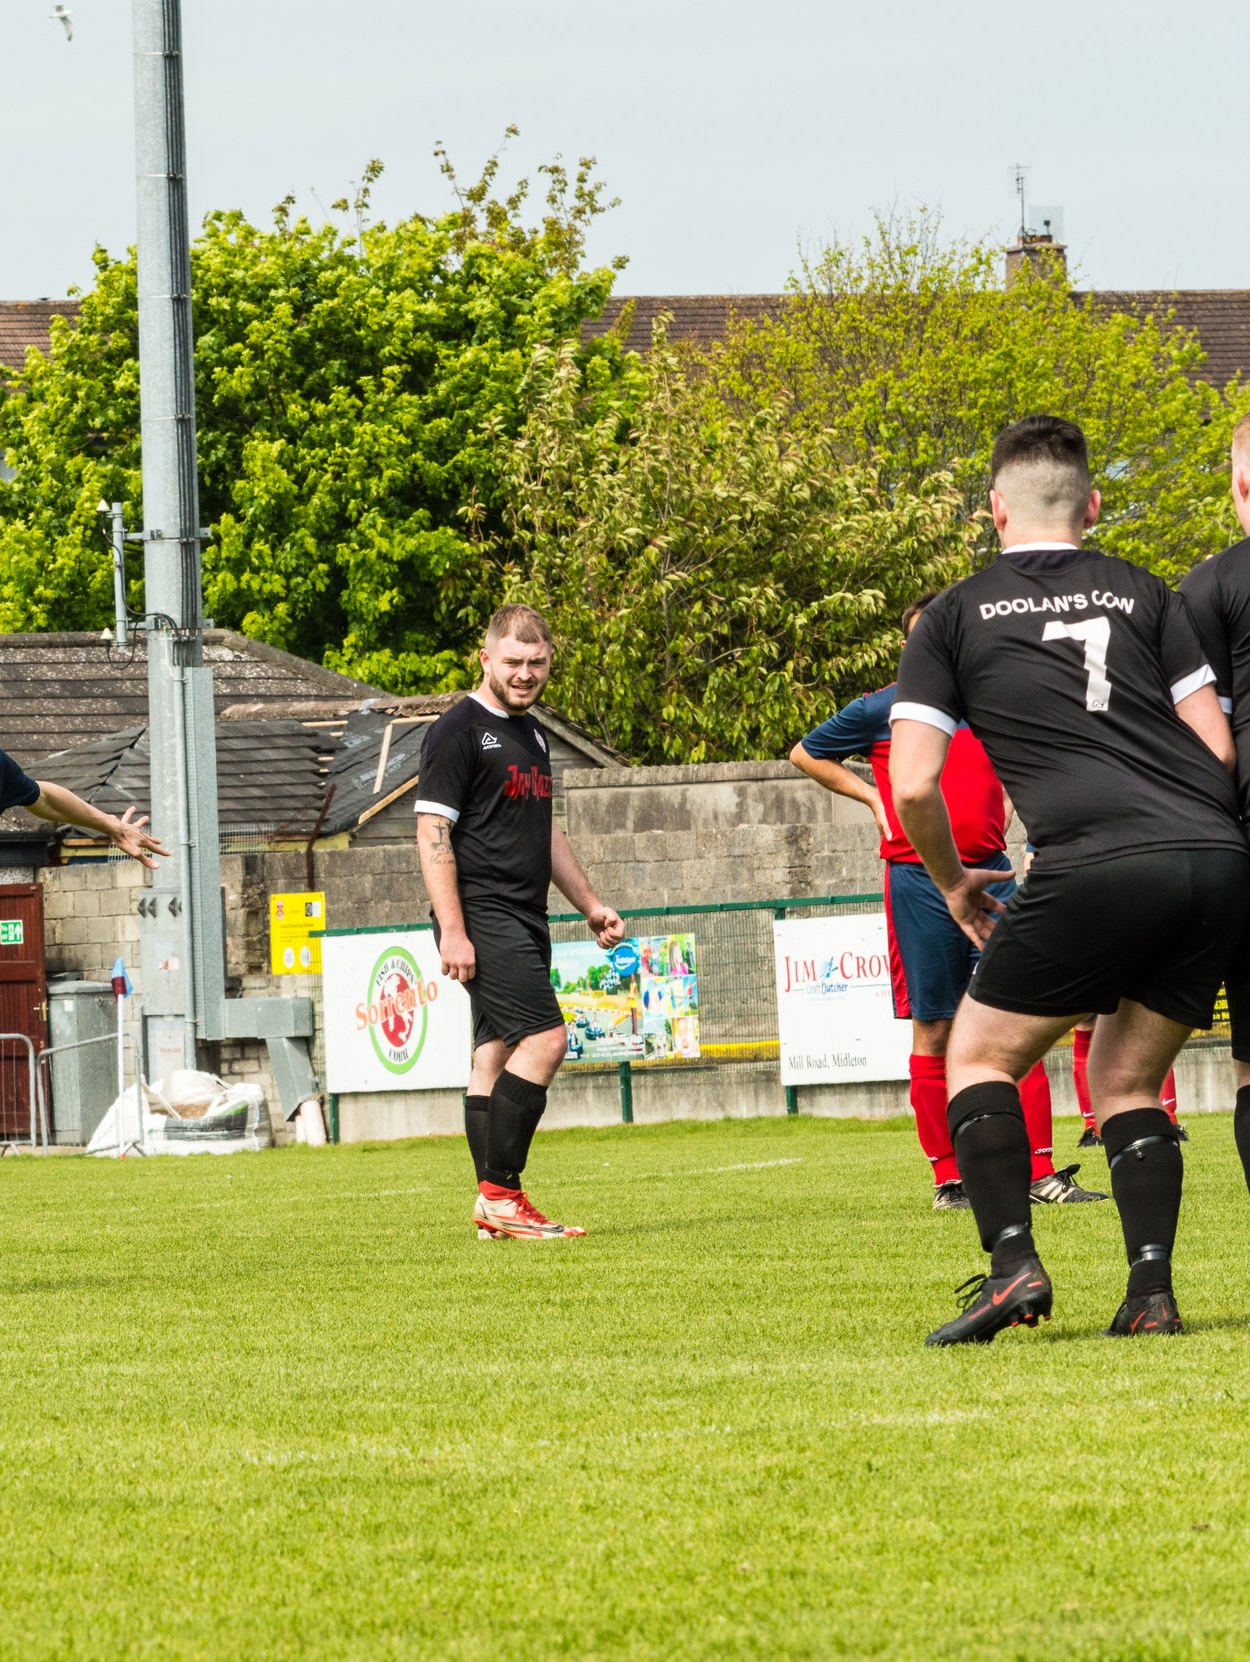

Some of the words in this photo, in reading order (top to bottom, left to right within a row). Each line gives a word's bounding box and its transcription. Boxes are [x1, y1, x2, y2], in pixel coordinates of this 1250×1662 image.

[979, 592, 1089, 620] DOOLAN'S
[1091, 589, 1135, 615] COW
[1042, 616, 1112, 712] 7
[784, 955, 817, 993] JIM
[355, 979, 438, 1031] Sorrento
[788, 1055, 804, 1070] Mill
[806, 1053, 830, 1070] Road,
[832, 1052, 868, 1068] Midleton
